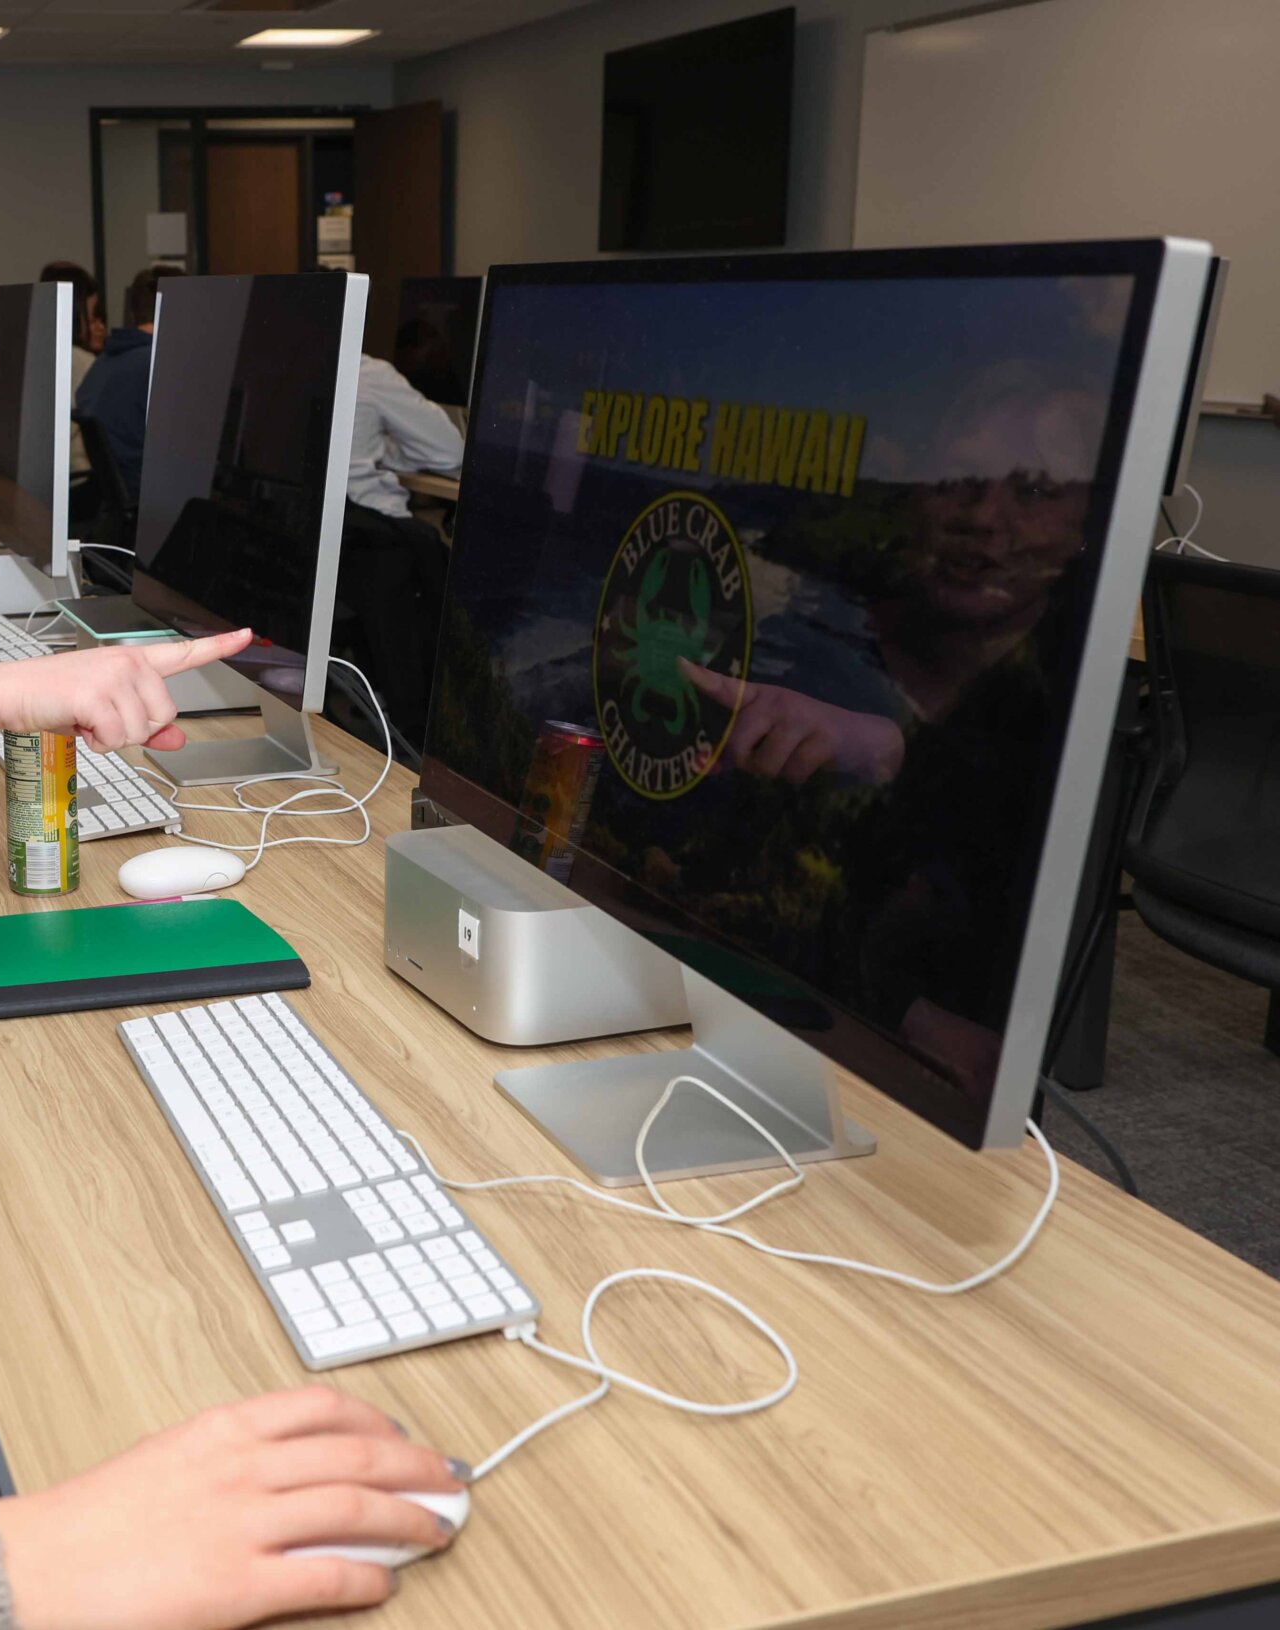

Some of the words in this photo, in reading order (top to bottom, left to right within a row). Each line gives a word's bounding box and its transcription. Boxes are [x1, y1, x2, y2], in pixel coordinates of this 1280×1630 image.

[577, 389, 709, 471] EXPLORE
[710, 403, 867, 497] HAWAII
[621, 501, 681, 576] BLUE
[686, 504, 741, 602] CRAB
[29, 738, 40, 747] 10
[602, 699, 713, 791] CHARTERS
[463, 925, 472, 942] 19
